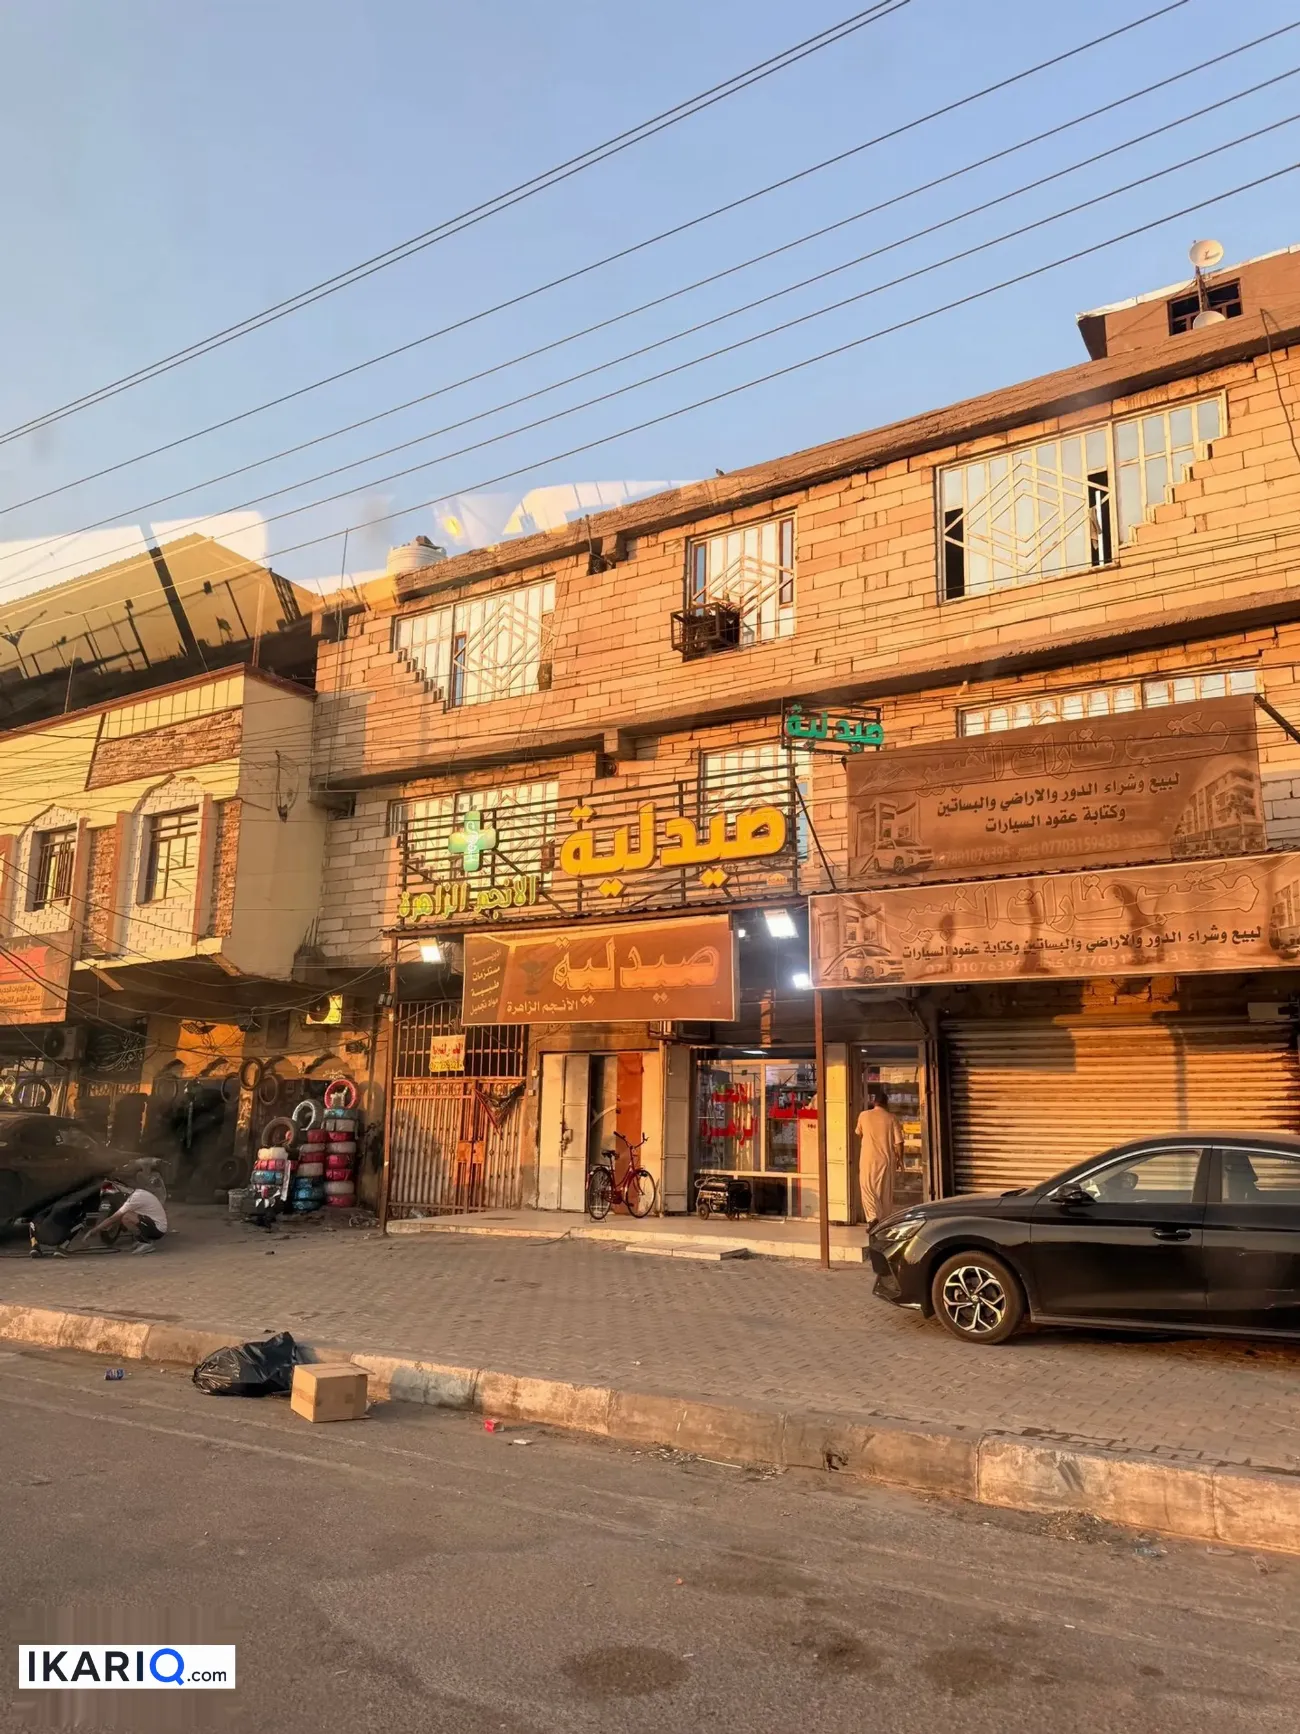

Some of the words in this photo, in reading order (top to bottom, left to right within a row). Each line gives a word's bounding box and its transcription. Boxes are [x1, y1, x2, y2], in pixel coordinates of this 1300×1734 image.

[785, 703, 884, 753] صيدلية
[1124, 711, 1230, 768] مكتب
[1011, 728, 1116, 780] عقارات
[1062, 782, 1098, 802] الدور
[1104, 775, 1145, 796] وشراء
[1149, 772, 1181, 793] لبيع
[937, 796, 996, 817] والبساتين
[1000, 788, 1058, 811] والاراضي
[985, 814, 1041, 834] السيارات
[1045, 807, 1078, 827] عقود
[1083, 804, 1126, 826] وكتابة
[559, 801, 788, 899] صيدلية
[398, 882, 471, 922] الزاهرة
[1007, 873, 1125, 934] عقارات
[1136, 861, 1260, 926] مكتب
[1086, 932, 1143, 953] والاراضي
[1149, 929, 1182, 948] الدور
[1188, 924, 1228, 946] وشراء
[1232, 926, 1261, 945] لبيع
[902, 945, 949, 961] السيارات
[952, 943, 979, 958] عقود
[984, 940, 1020, 957] وكتابة
[1024, 938, 1082, 956] والبساتين
[552, 937, 720, 1004] صيدلية
[506, 1001, 540, 1016] الزاهرة
